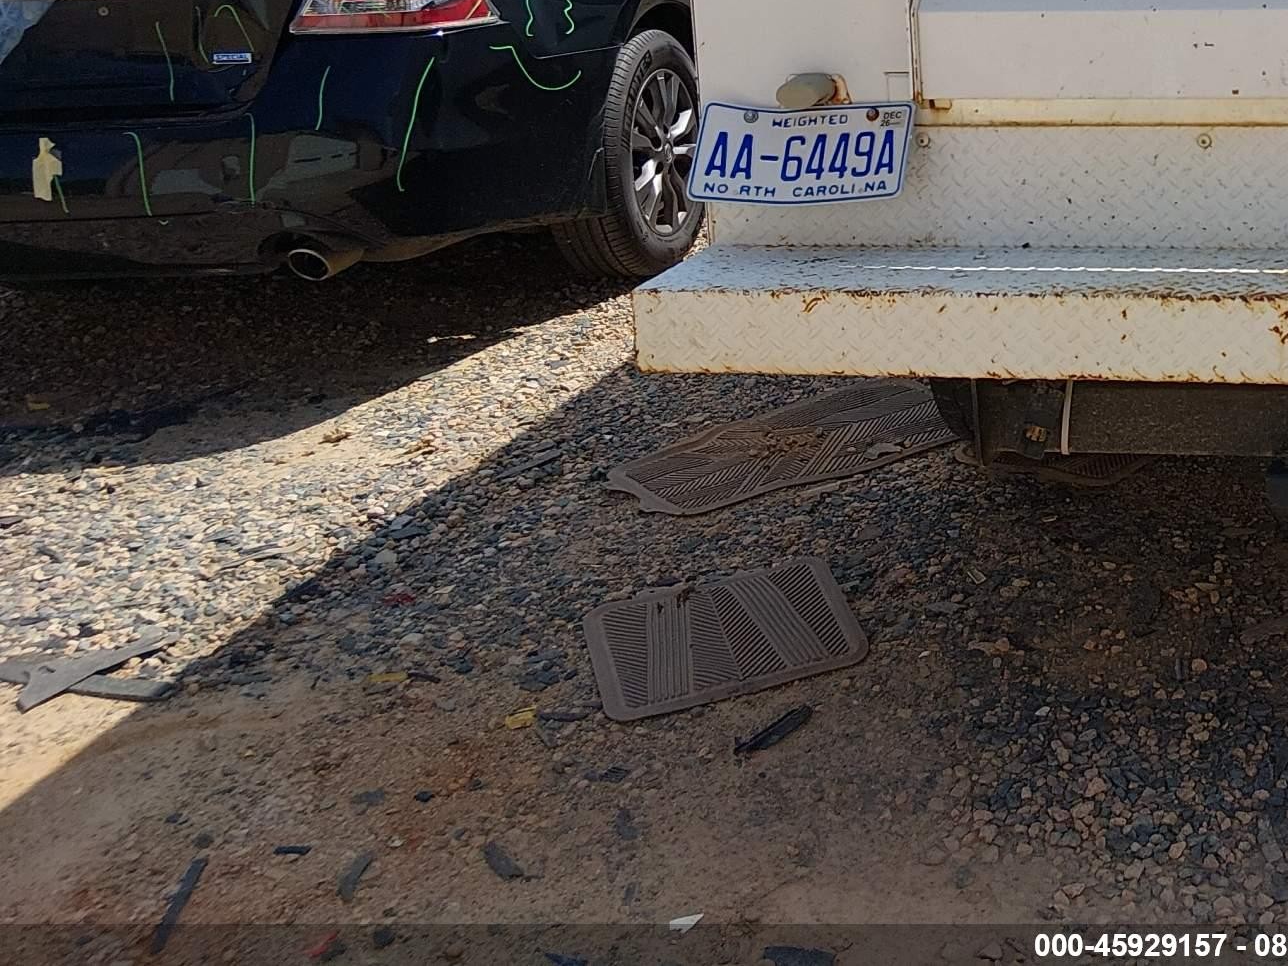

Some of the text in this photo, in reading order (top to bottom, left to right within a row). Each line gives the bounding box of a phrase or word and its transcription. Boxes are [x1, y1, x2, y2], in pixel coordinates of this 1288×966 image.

[772, 114, 849, 129] WEIGHTED
[883, 111, 902, 120] DEC
[704, 129, 894, 182] AA-6449A
[792, 180, 887, 198] CAROLINA
